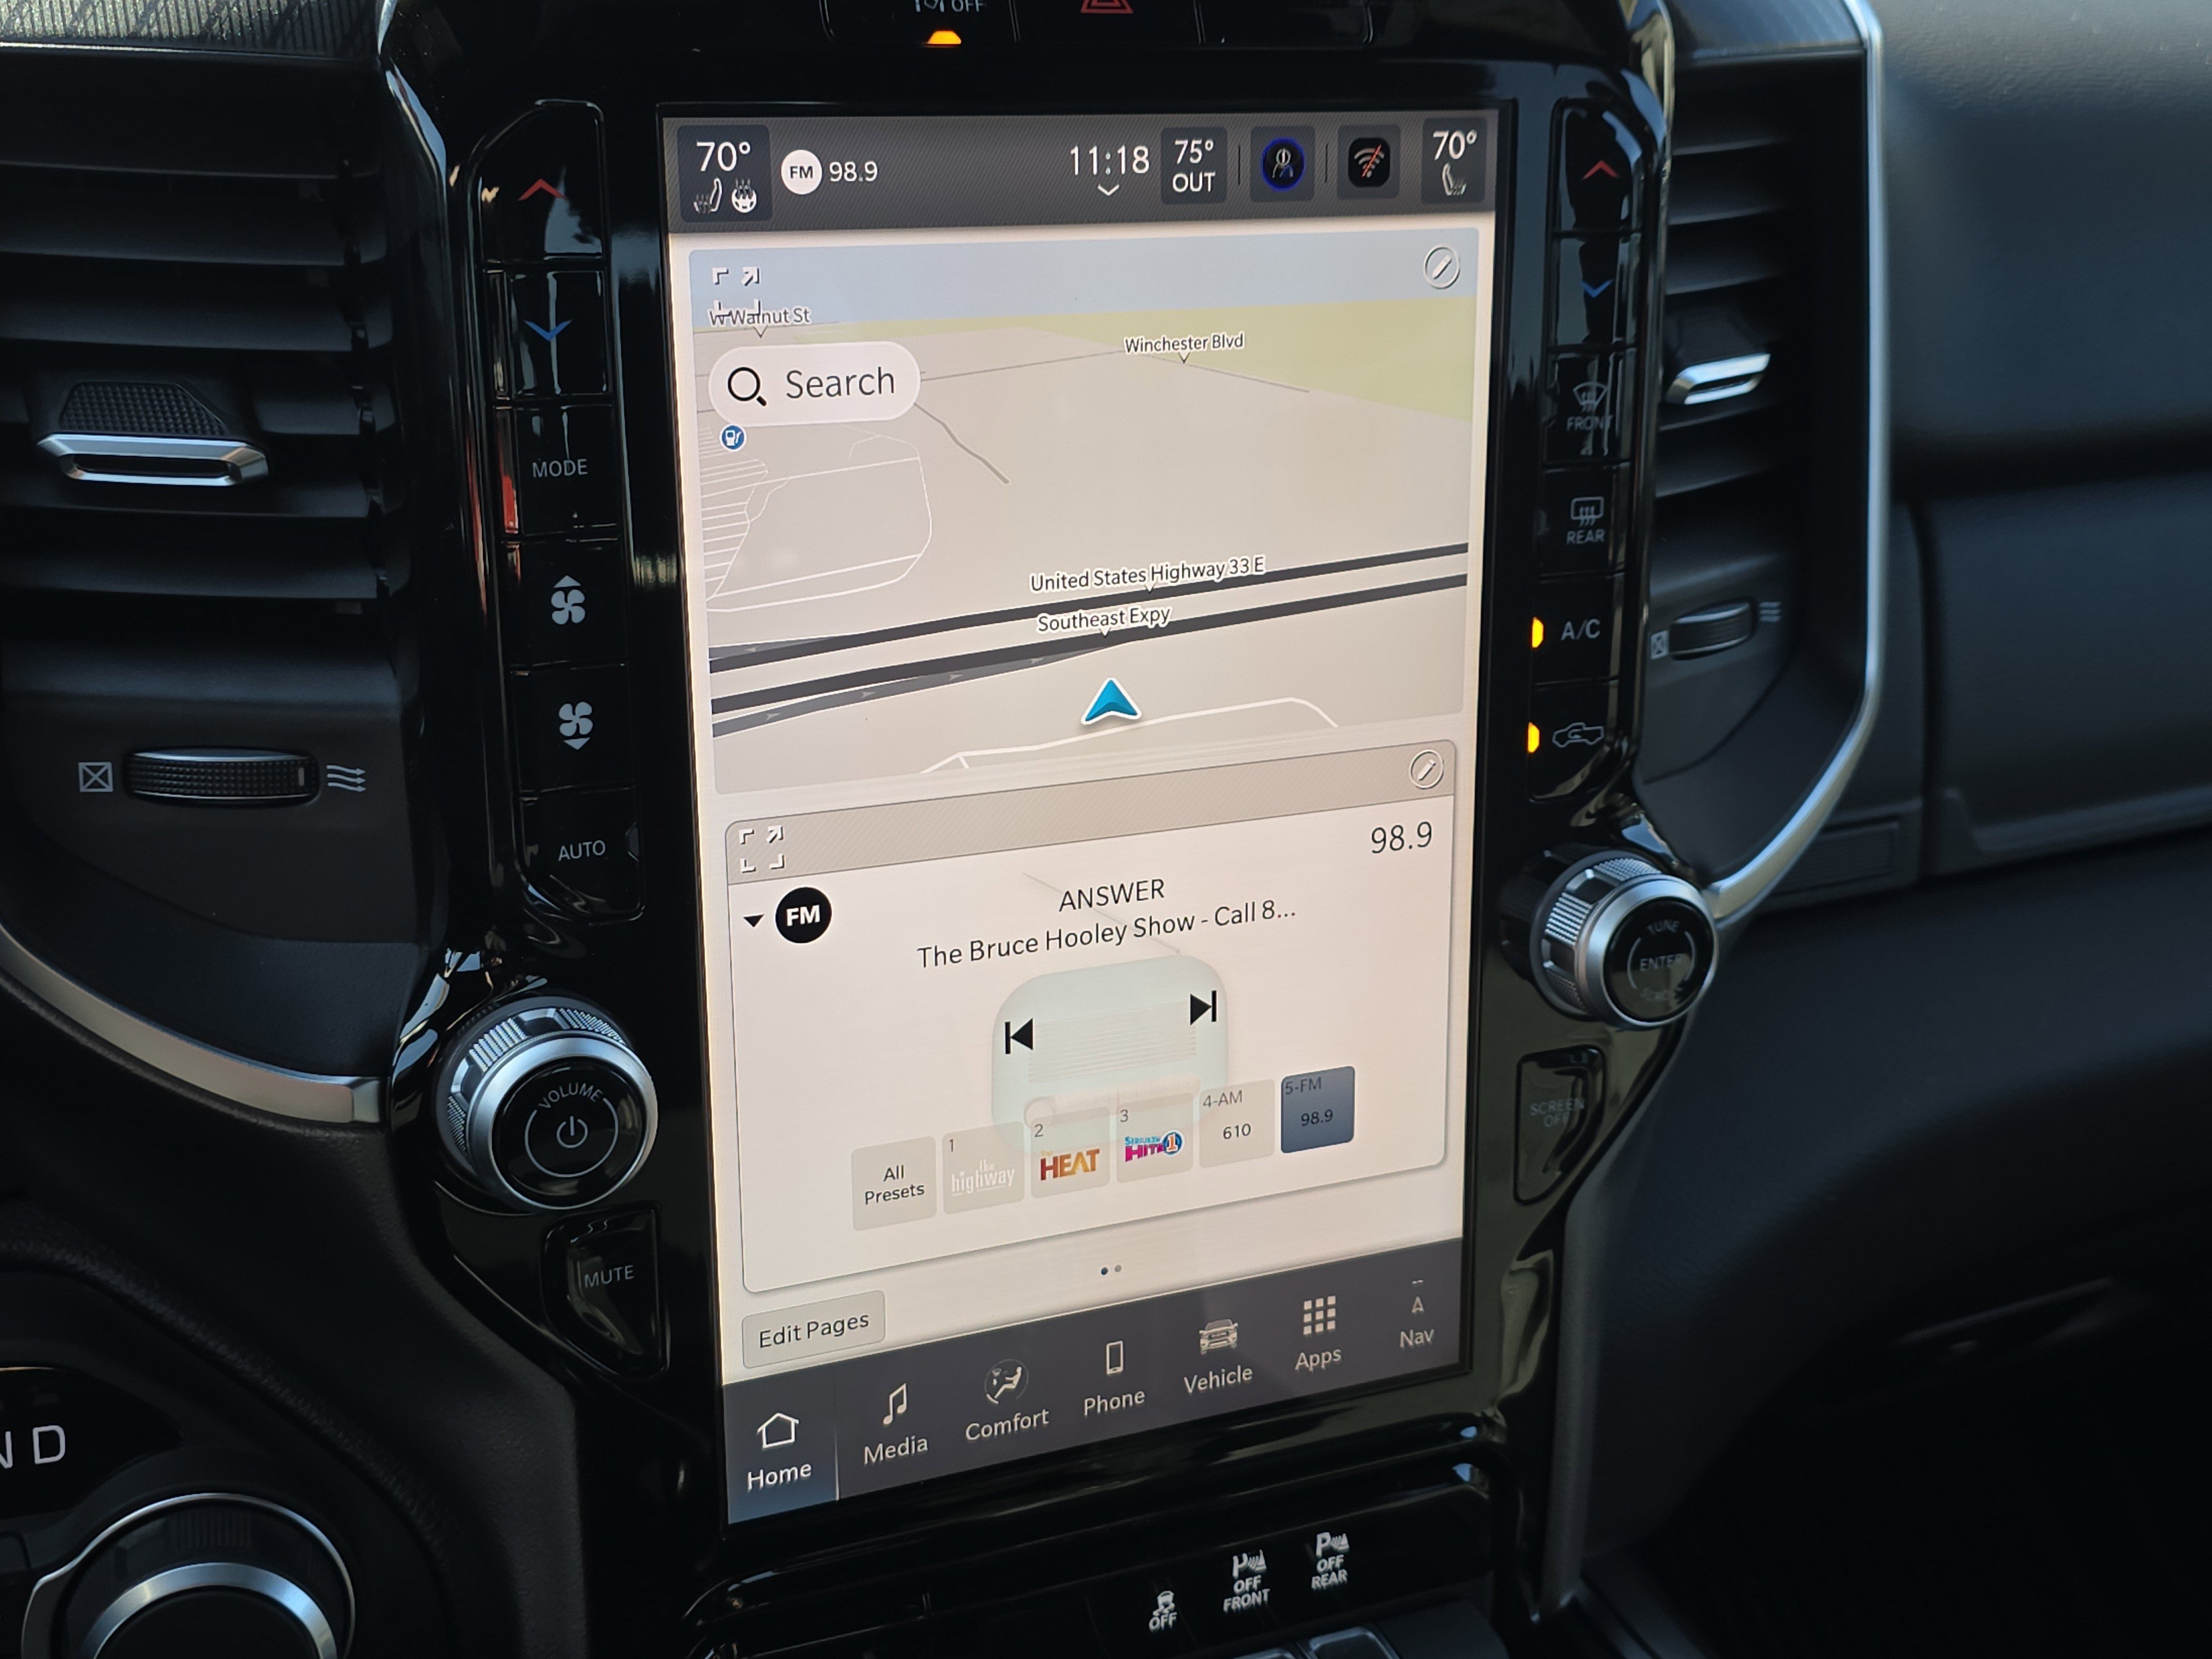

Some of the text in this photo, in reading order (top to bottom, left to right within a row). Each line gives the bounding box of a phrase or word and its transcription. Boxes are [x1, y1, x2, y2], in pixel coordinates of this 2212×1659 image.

[696, 141, 751, 172] 70°
[1175, 139, 1214, 165] 75°
[1433, 130, 1477, 161] 70°
[830, 161, 878, 182] 98.9
[1071, 145, 1150, 176] 11:18
[790, 165, 813, 180] FM
[1172, 171, 1216, 193] OUT
[729, 309, 789, 325] Walnut
[794, 308, 810, 322] St
[1125, 333, 1244, 354] Winchester Blvd
[786, 366, 895, 399] Search
[1567, 415, 1612, 431] FRONT
[533, 458, 588, 478] MODE
[1567, 529, 1605, 544] REAR
[1031, 557, 1264, 592] United States Highway 33 E
[1037, 607, 1171, 632] Southeast Expy
[1561, 618, 1601, 641] A/C
[1371, 821, 1433, 854] 98.9
[559, 839, 606, 862] AUTO
[1058, 878, 1165, 912] ANSWER
[786, 904, 821, 927] FM
[916, 945, 963, 969] The
[970, 936, 1039, 963] Bruce
[1046, 922, 1127, 951] Hooley
[1133, 913, 1196, 939] Show
[1214, 902, 1256, 927] Call
[1647, 919, 1681, 936] TUNE
[538, 1082, 604, 1108] VOLUME
[1285, 1076, 1322, 1094] 5-FM
[1203, 1089, 1243, 1108] 4-AM
[1120, 1109, 1129, 1123] 3
[1301, 1109, 1334, 1127] 98.9
[1034, 1123, 1044, 1138] 2
[1223, 1123, 1251, 1140] 610
[948, 1138, 955, 1152] 1
[883, 1165, 905, 1182] All
[979, 1159, 996, 1173] the
[1040, 1148, 1100, 1181] HEAT
[951, 1166, 1016, 1194] highway
[865, 1183, 926, 1206] Presets
[584, 1264, 635, 1288] MUTE
[759, 1313, 870, 1348] Edit Pages
[1400, 1328, 1434, 1349] Nav
[1295, 1347, 1342, 1373] Apps
[1183, 1365, 1253, 1394] Vehicle
[1084, 1389, 1145, 1416] Phone
[966, 1408, 1050, 1441] Comfort
[33, 1425, 66, 1464] D
[864, 1436, 929, 1465] Media
[748, 1462, 812, 1491] Home
[1316, 1554, 1344, 1573] OFF
[1233, 1575, 1262, 1595] OFF
[1311, 1569, 1348, 1590] REAR
[1223, 1588, 1270, 1614] FRONT
[1149, 1611, 1177, 1632] OFF
